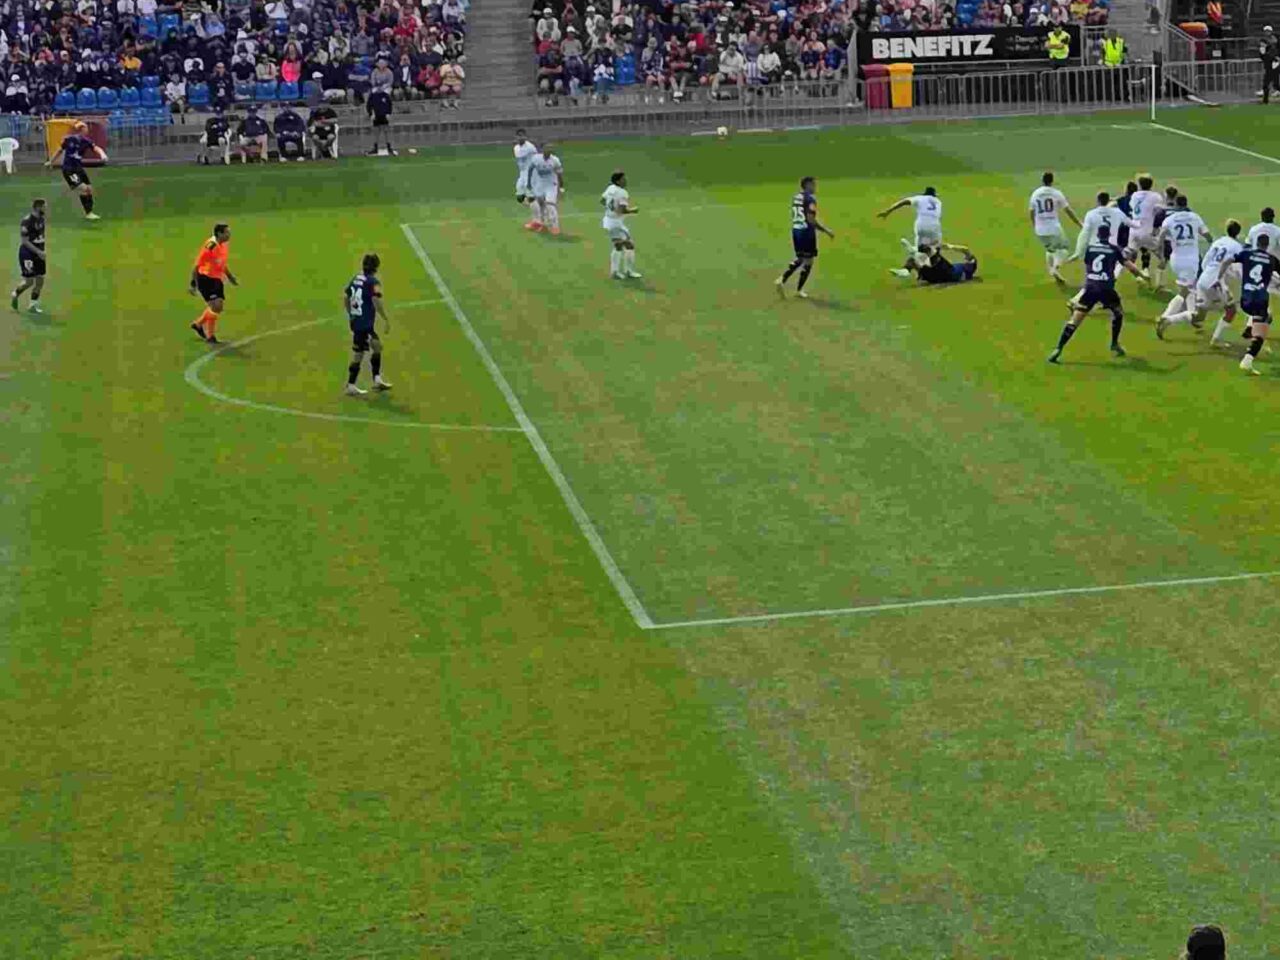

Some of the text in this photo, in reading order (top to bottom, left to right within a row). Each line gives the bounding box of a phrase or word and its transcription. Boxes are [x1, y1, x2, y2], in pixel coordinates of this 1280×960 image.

[872, 34, 995, 59] BENEFITZ
[1036, 198, 1053, 214] 10
[1174, 223, 1194, 240] 21
[1092, 254, 1105, 273] 6
[1249, 264, 1263, 283] 4
